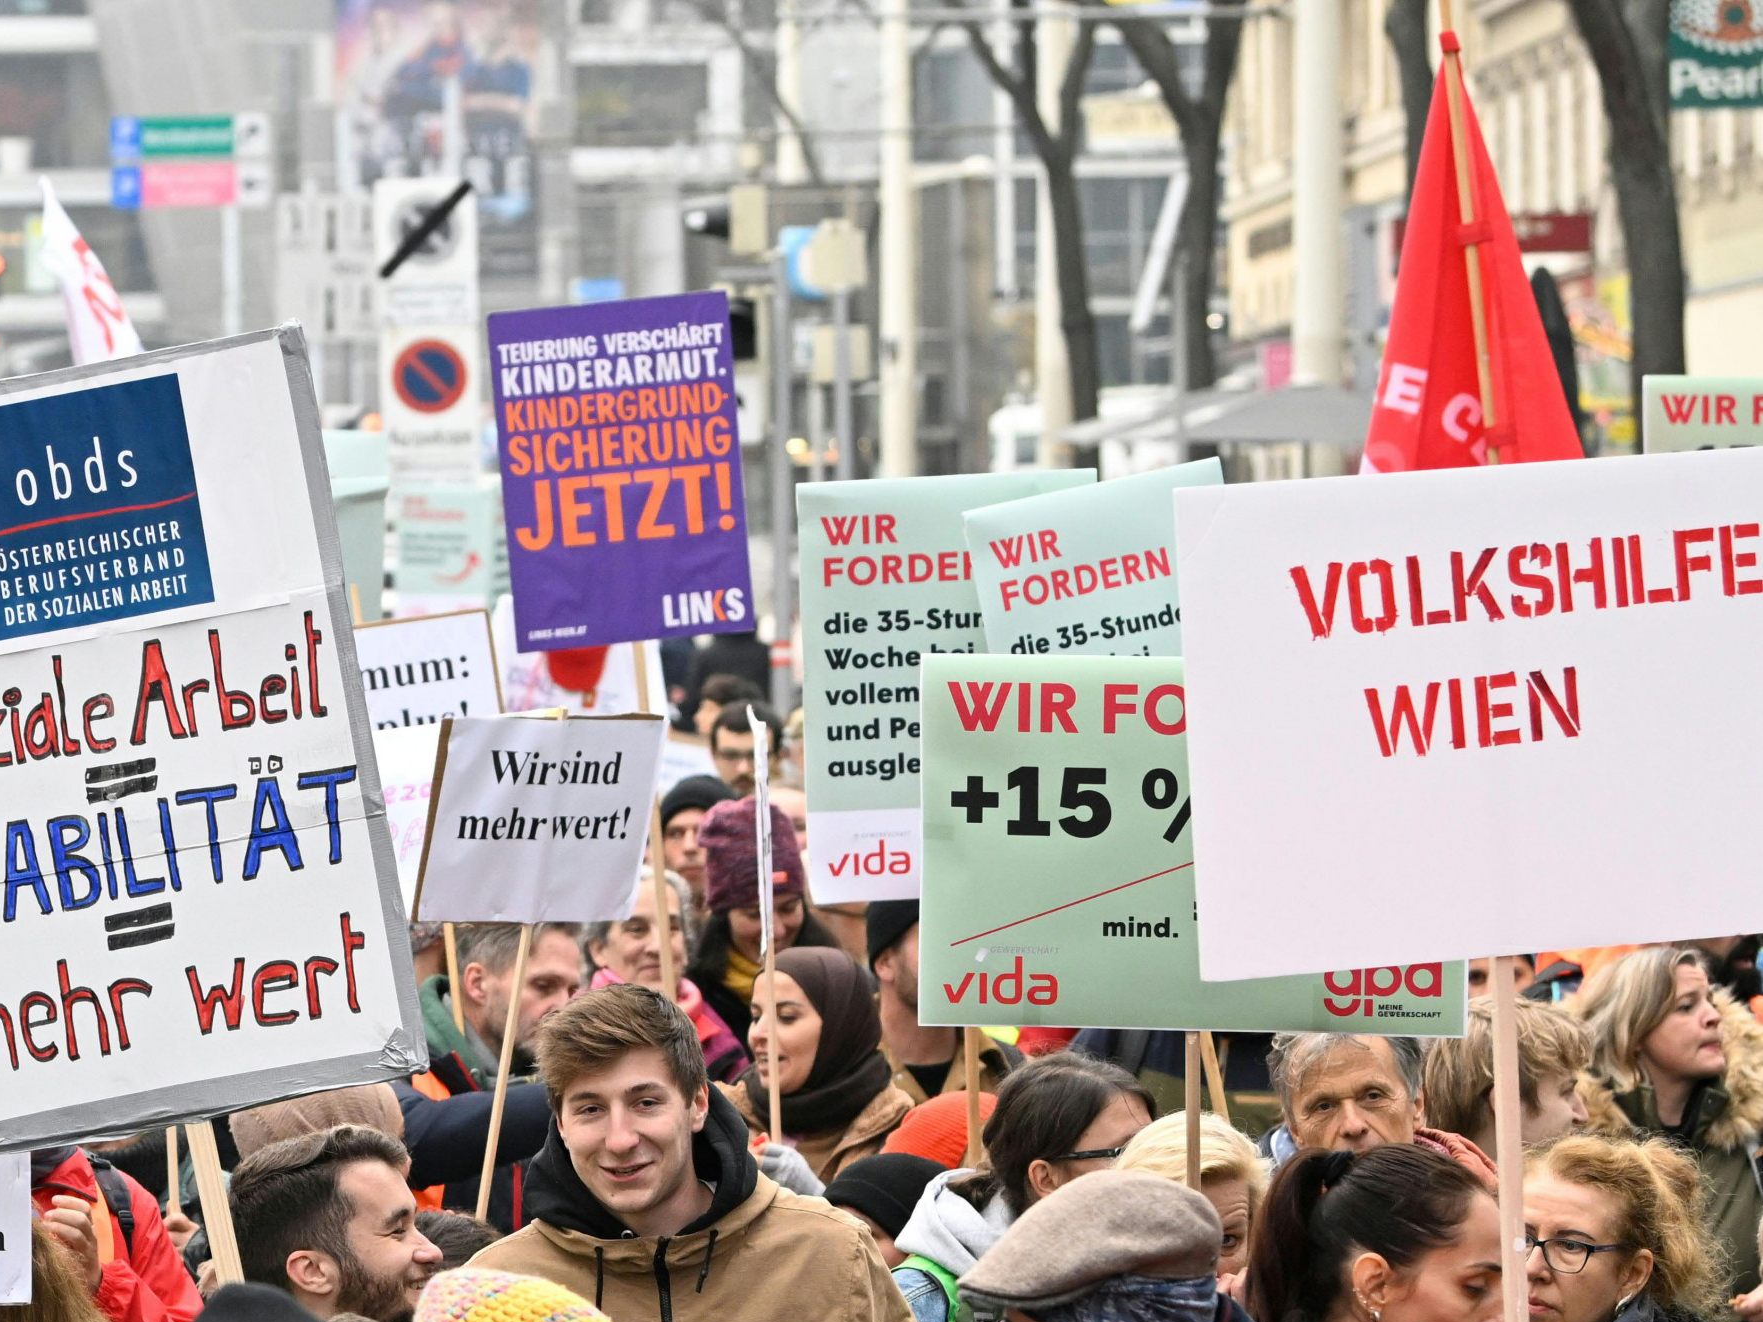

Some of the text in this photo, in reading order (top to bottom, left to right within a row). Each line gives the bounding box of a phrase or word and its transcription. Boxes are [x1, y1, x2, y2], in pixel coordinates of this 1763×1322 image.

[1669, 58, 1763, 100] Pear
[498, 322, 724, 366] TEUERUNG VERSCHÄRFT
[500, 348, 727, 398] KINDERARMUT.
[504, 382, 729, 433] KINDERGRUND-
[1660, 394, 1737, 427] WIR
[507, 415, 732, 477] SICHERUNG
[16, 435, 140, 507] obds
[515, 461, 736, 552] JETZT!
[820, 513, 899, 546] WIR
[989, 528, 1063, 569] WIR
[0, 547, 187, 602] BERUFSVERBAND
[999, 547, 1172, 613] FORDERN
[1290, 522, 1763, 641] VOLKSHILFE
[3, 573, 189, 628] DER SOZIALEN ARBEIT
[662, 587, 746, 628] LINKS
[823, 611, 869, 635] die
[825, 645, 921, 671] Woche
[1010, 633, 1051, 656] die
[129, 610, 329, 746] Arbeit
[361, 655, 470, 691] mum:
[825, 682, 920, 706] vollem
[947, 681, 1186, 736] WIR FO
[1365, 665, 1582, 758] WIEN
[827, 716, 921, 742] und Pe
[491, 749, 557, 786] Wir
[558, 750, 623, 786] sind
[827, 753, 921, 781] ausgle
[950, 765, 1113, 839] +15
[456, 806, 547, 842] mehr
[550, 806, 632, 842] wert!
[828, 839, 912, 878] vida
[1102, 916, 1180, 940] mind.
[185, 912, 366, 1037] wert
[942, 955, 1059, 1006] vida
[1377, 1010, 1442, 1019] GEWERKSCHAFT
[1378, 1003, 1405, 1012] MEINE
